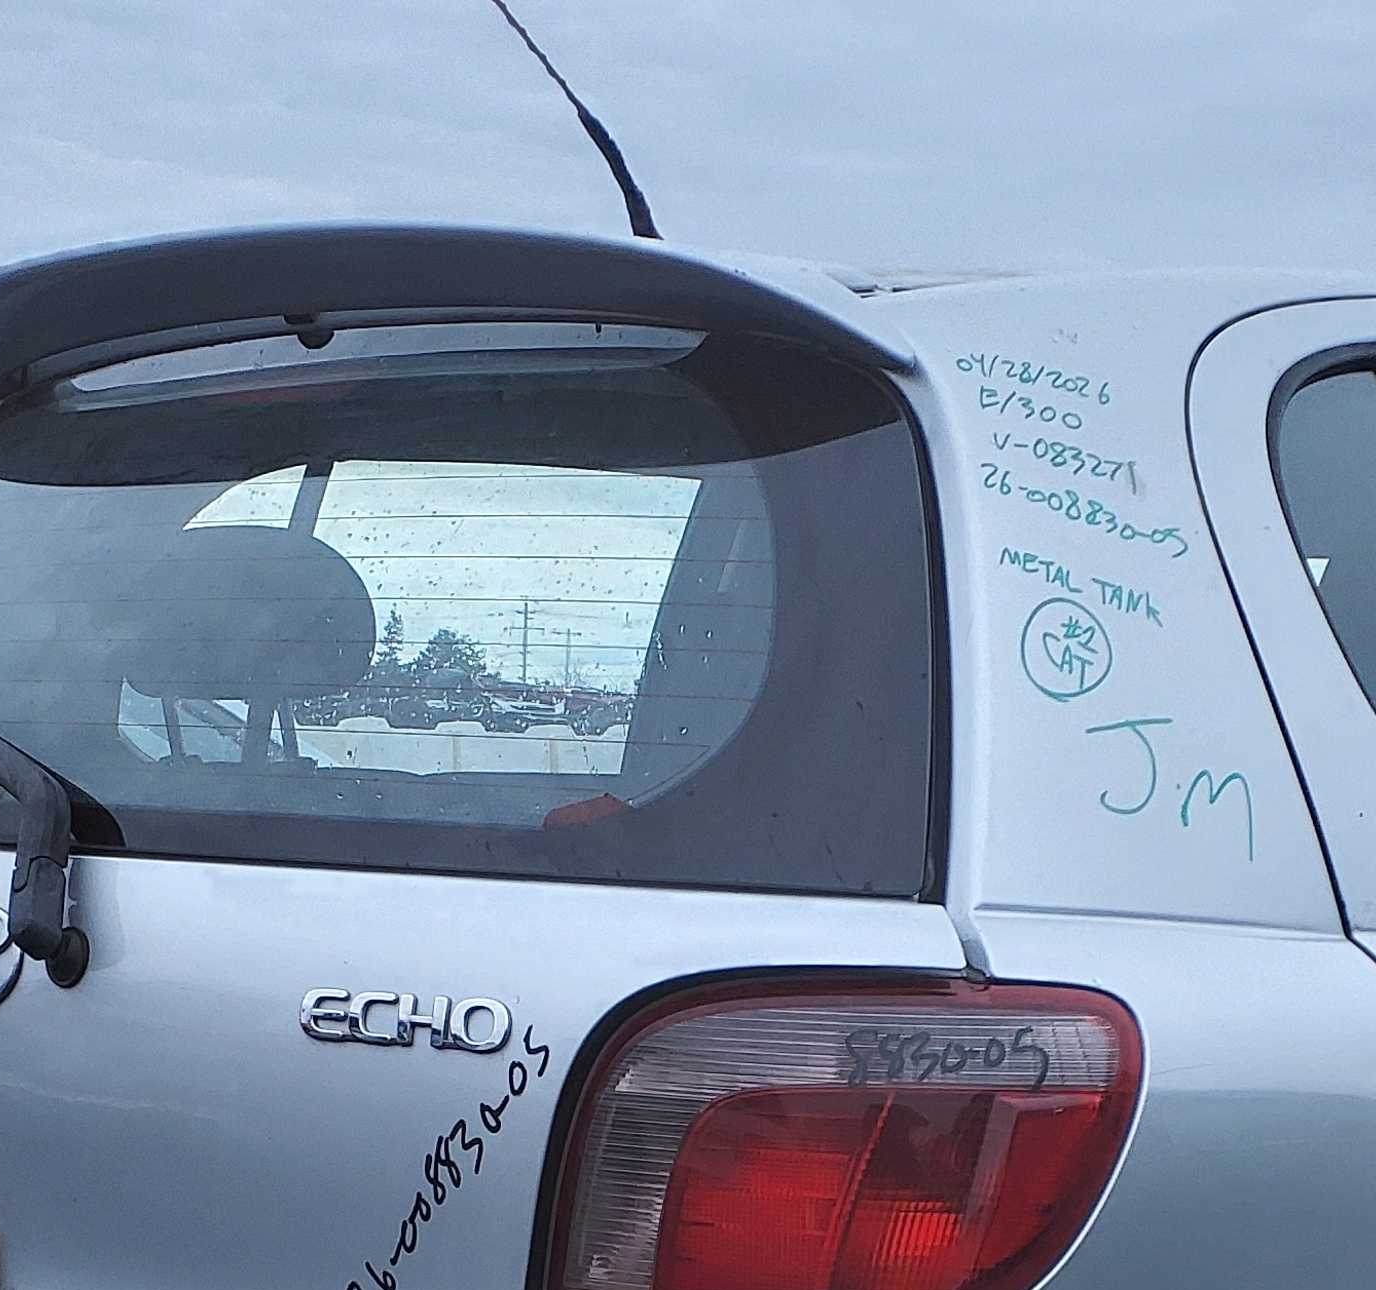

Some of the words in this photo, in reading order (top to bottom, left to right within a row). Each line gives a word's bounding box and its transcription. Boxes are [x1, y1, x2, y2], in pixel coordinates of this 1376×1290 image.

[956, 353, 1111, 405] 04/28/2026
[980, 462, 1189, 559] 26-008830-05
[1000, 547, 1084, 593] METAL
[1091, 577, 1164, 628] TANK
[1042, 631, 1095, 690] CAT
[299, 986, 513, 1056] ECHO
